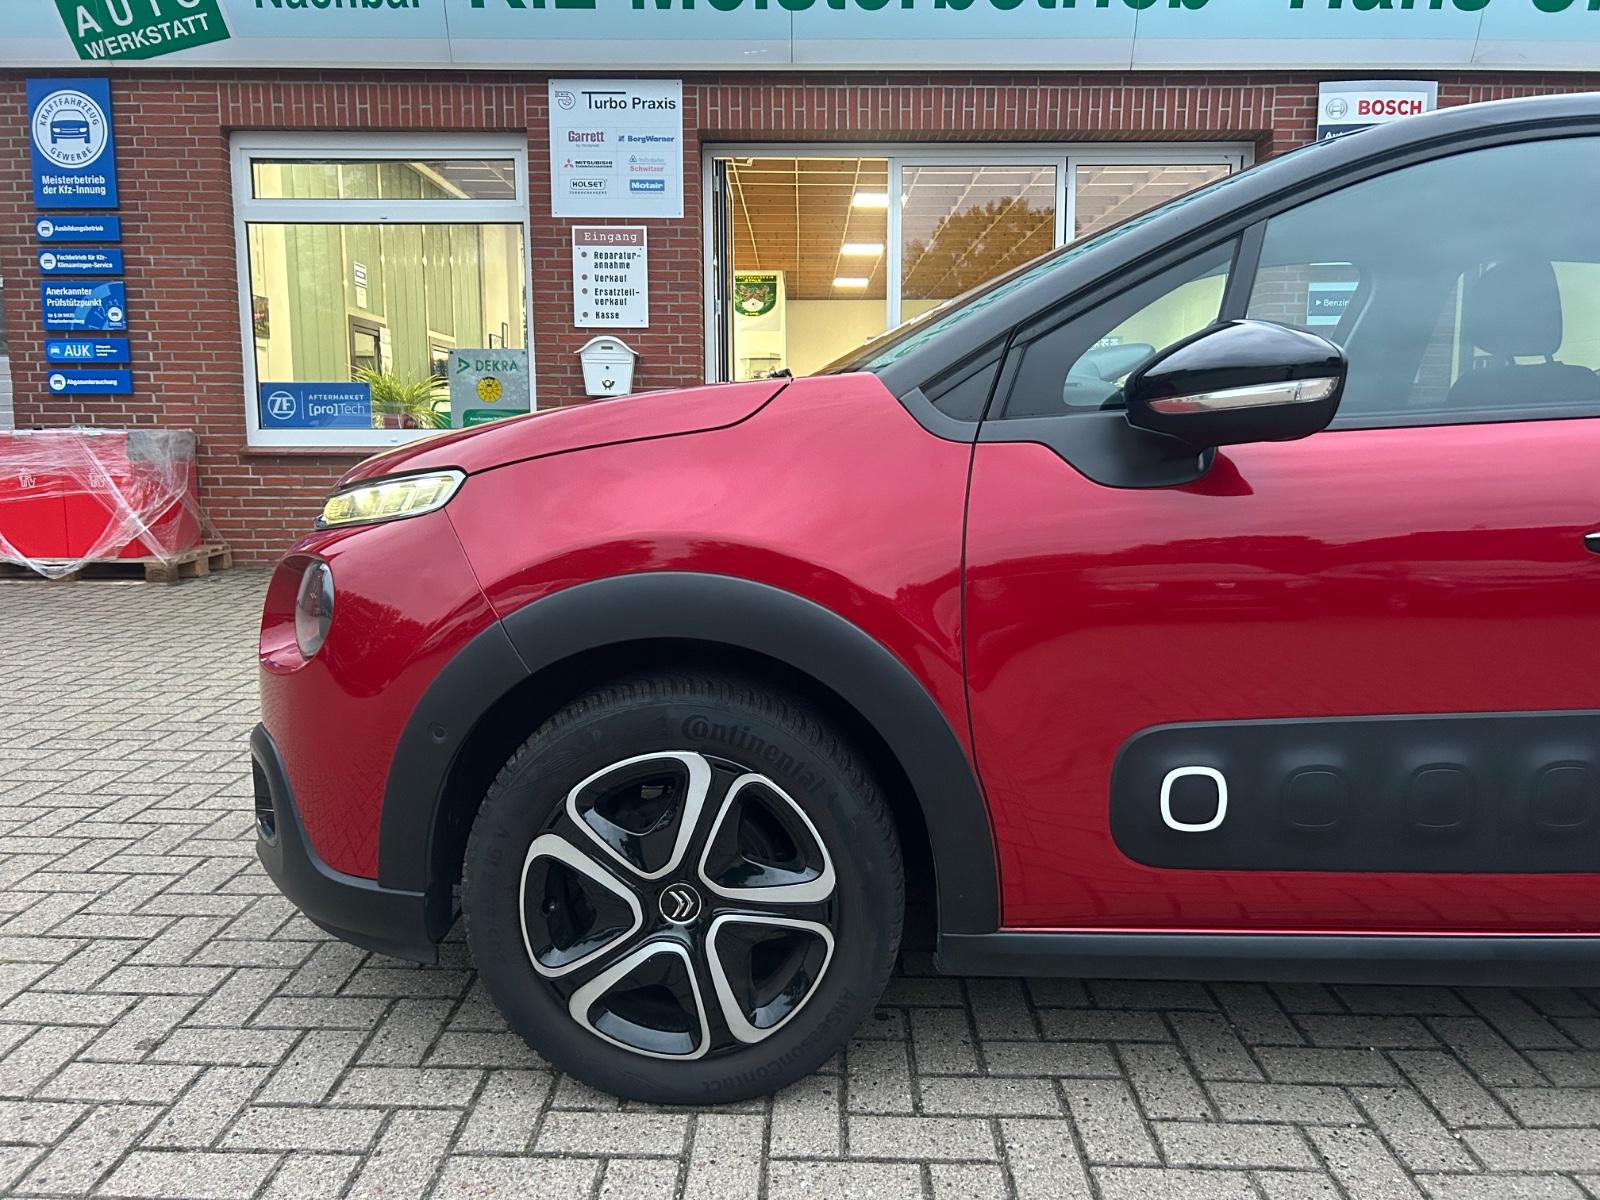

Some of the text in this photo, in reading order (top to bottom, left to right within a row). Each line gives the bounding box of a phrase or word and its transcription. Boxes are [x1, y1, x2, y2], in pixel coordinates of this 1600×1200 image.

[84, 12, 209, 59] WERKSTATT
[581, 91, 677, 110] Turbo Praxis
[40, 97, 100, 126] KRAFTFAHRZEUG
[1358, 99, 1422, 116] BOSCH
[568, 130, 605, 143] Garrett
[627, 135, 675, 144] BorgWarner
[50, 146, 93, 161] GEWERBE
[41, 175, 106, 185] Meisterbetrieb
[42, 185, 106, 196] der Kfz-Innung
[583, 232, 638, 243] Eingang
[593, 251, 642, 260] Reparatur-
[593, 260, 631, 270] annahme
[594, 274, 628, 283] Verkauf
[46, 287, 93, 296] Anerkannter
[594, 287, 640, 297] Ersatzteil-
[46, 298, 103, 309] Prüfstützpunkt
[595, 311, 620, 320] Kasse
[475, 359, 519, 372] DEKRA
[269, 395, 296, 415] ZF
[681, 713, 827, 793] Continental
